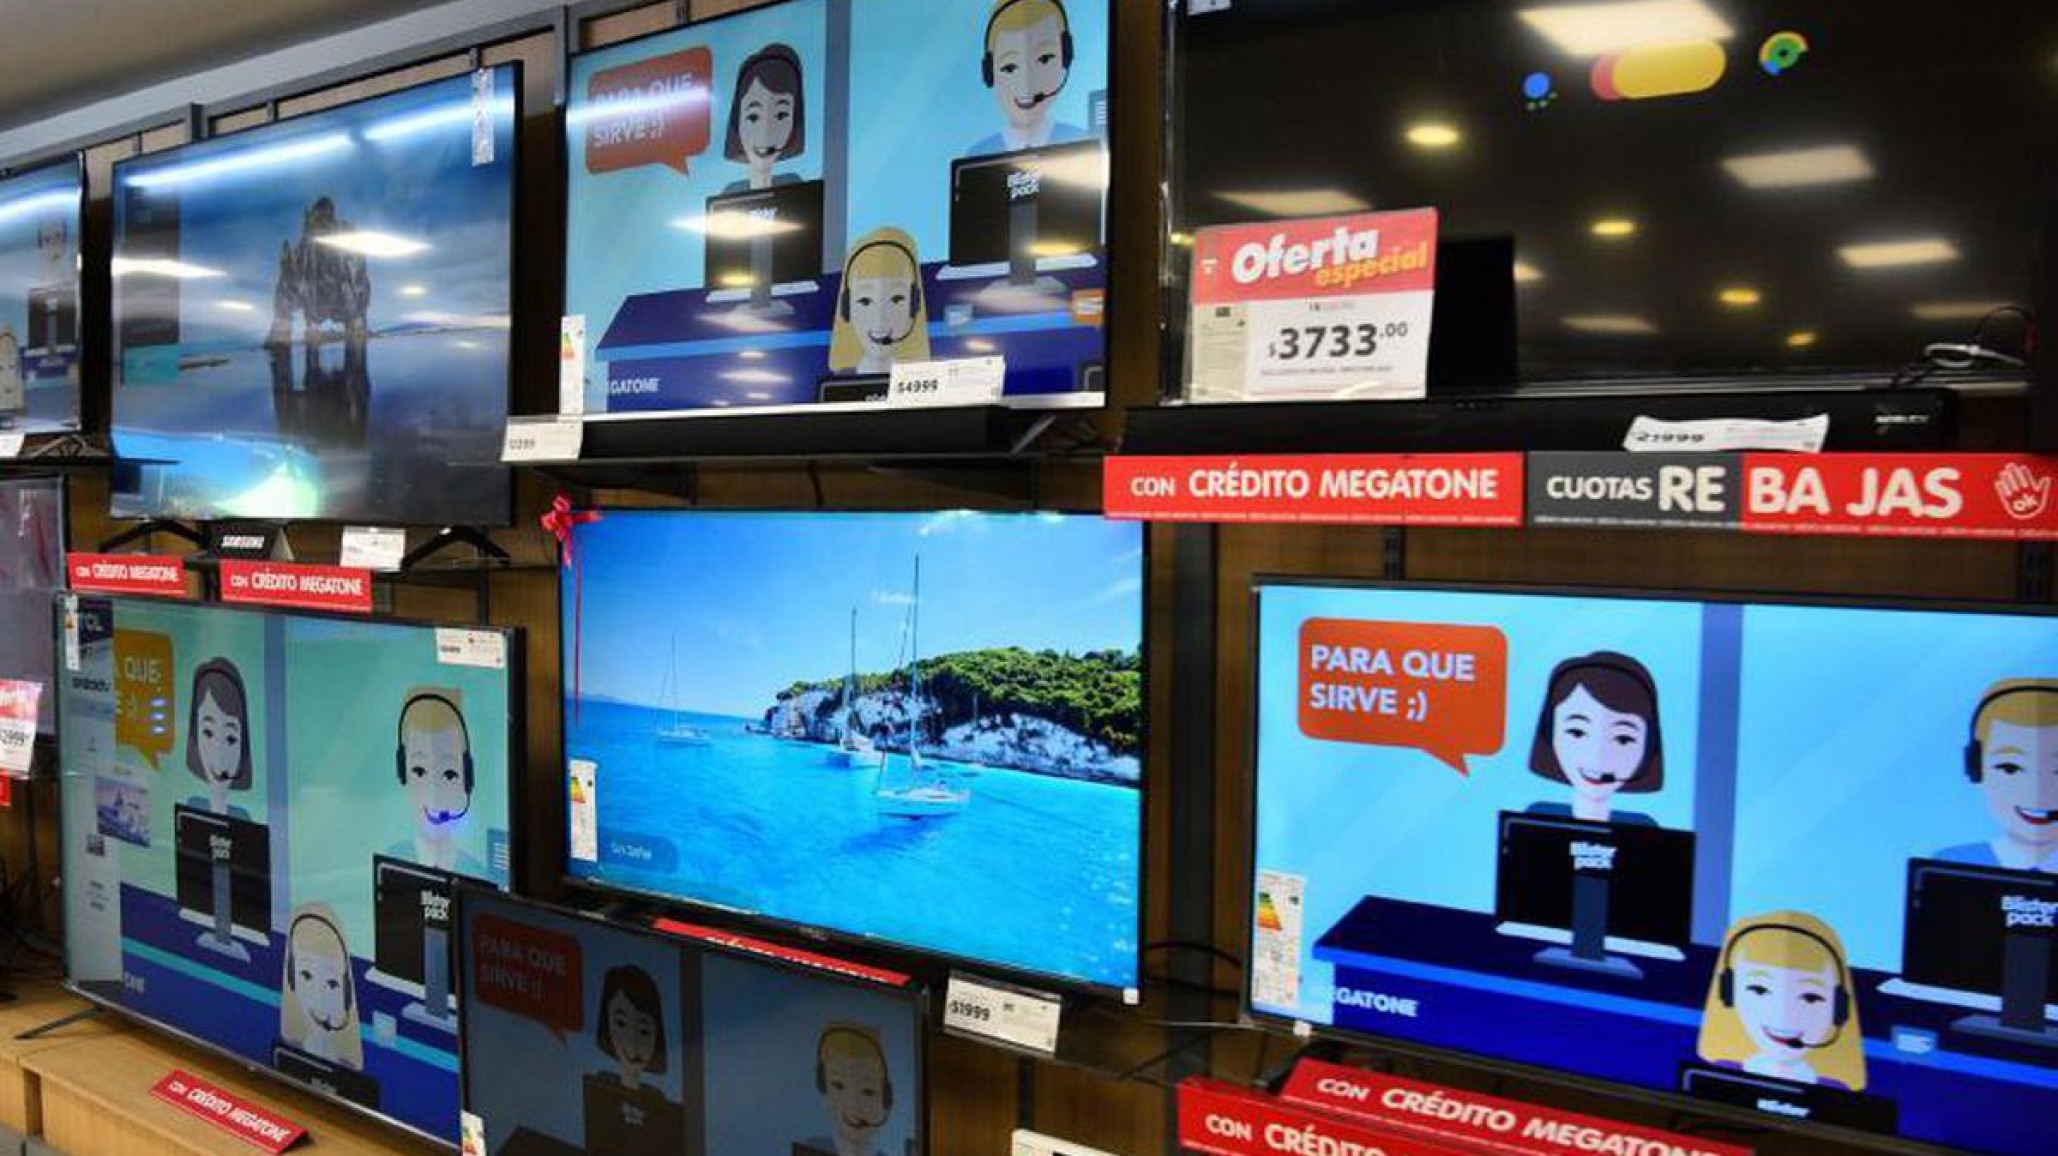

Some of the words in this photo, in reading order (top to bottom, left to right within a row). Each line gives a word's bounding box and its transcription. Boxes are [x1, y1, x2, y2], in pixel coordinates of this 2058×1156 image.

[1231, 226, 1380, 284] Oferta
[1314, 241, 1428, 287] especial
[1130, 476, 1176, 497] CON
[1188, 461, 1310, 499] CRÉDITO
[1319, 468, 1499, 501] MEGATONE
[1545, 475, 1654, 502] CUOTAS
[1658, 464, 1726, 512] RE
[1749, 465, 1829, 516] BA
[1845, 466, 1963, 519] JAS
[251, 566, 298, 591] CRÉDITO
[299, 575, 363, 597] MEGATONE
[1310, 643, 1396, 676] PARA
[1401, 650, 1476, 682] QUE
[1309, 681, 1399, 715] SIRVE
[1316, 1077, 1370, 1102] CON
[1380, 1086, 1517, 1132] CRÉDITO
[1205, 1113, 1253, 1142] CON
